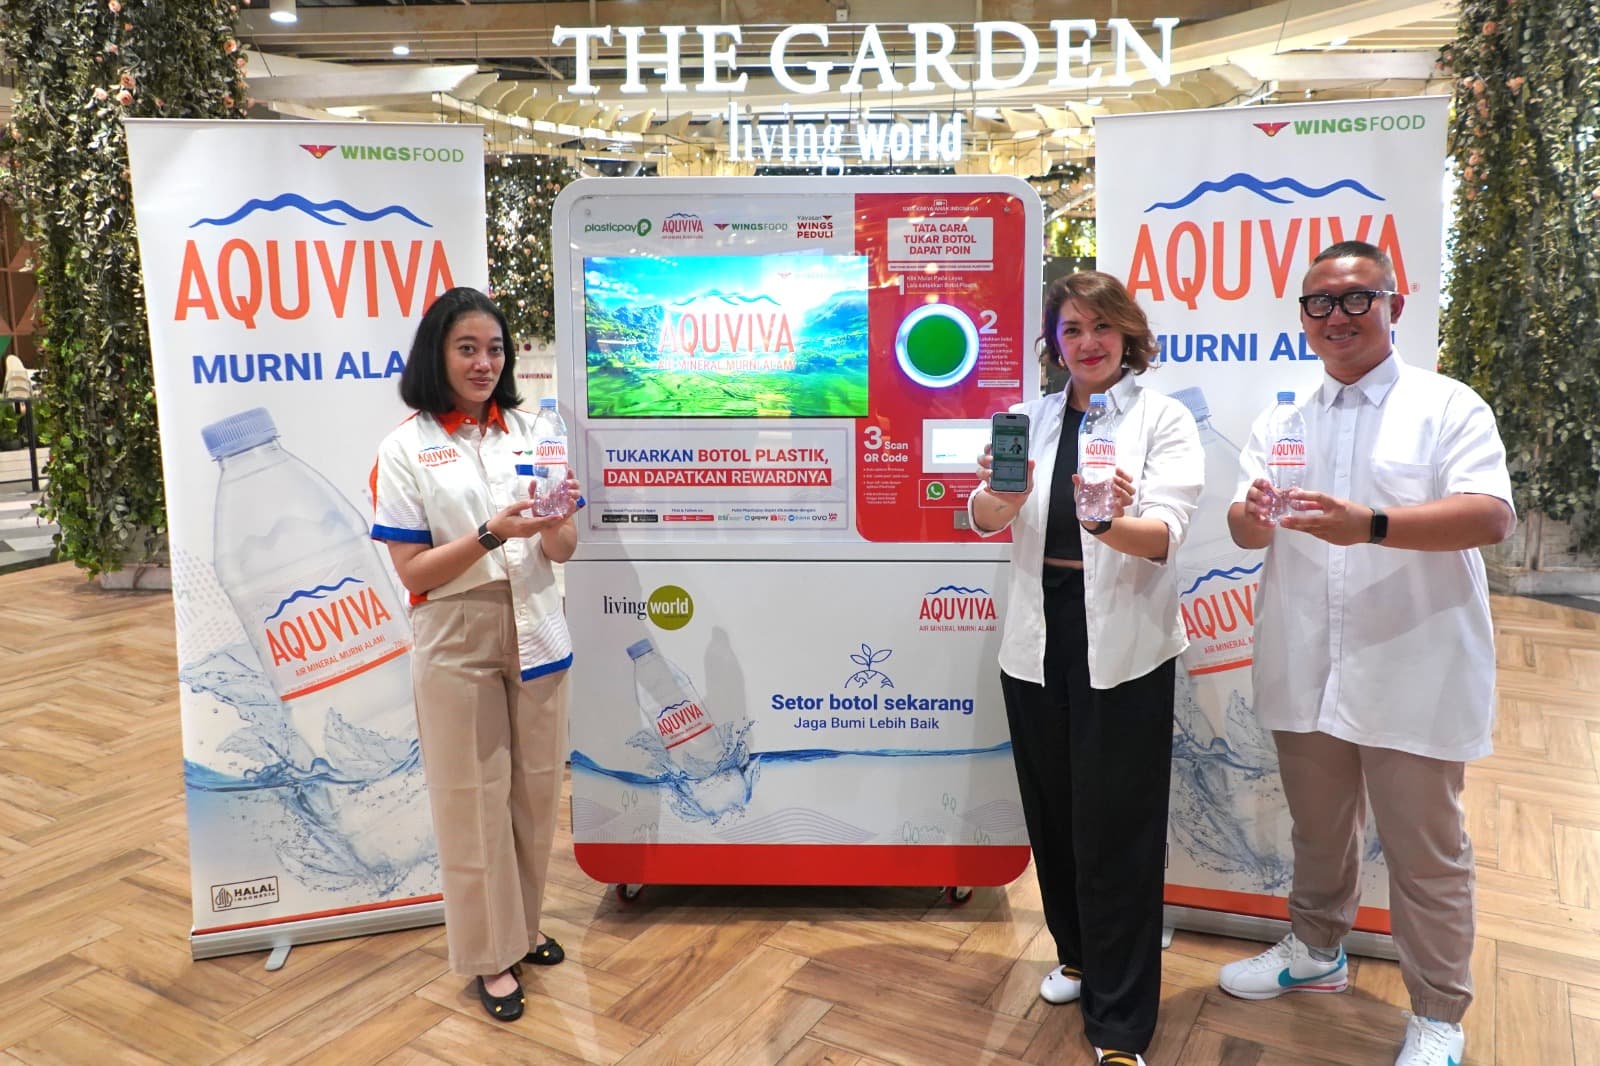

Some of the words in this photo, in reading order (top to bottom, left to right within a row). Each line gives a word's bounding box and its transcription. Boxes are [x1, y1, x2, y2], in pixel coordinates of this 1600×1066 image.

[551, 25, 748, 93] THE
[770, 18, 1180, 93] GARDEN
[1294, 115, 1425, 135] WINGSFOOD
[728, 101, 844, 176] living
[857, 112, 962, 161] world
[340, 145, 464, 162] WINGSFOOD
[584, 222, 638, 233] plasticpay
[662, 219, 704, 234] AQUVIVA
[731, 223, 788, 231] WINGSFOOD
[797, 222, 833, 230] WINGS
[797, 231, 833, 239] PEDULI
[912, 223, 937, 233] TATA
[939, 223, 968, 233] CARA
[904, 234, 940, 244] TUKAR
[942, 234, 977, 244] BOTOL
[909, 245, 942, 255] DAPAT
[945, 245, 971, 255] POIN
[174, 238, 456, 329] AQUVIVA
[979, 309, 998, 334] 2
[658, 313, 794, 356] AQUVIVA
[192, 353, 322, 384] MURNI
[335, 351, 407, 380] ALA
[864, 425, 882, 450] 3
[884, 441, 908, 450] Scan
[606, 449, 694, 463] TUKARKAN
[698, 449, 750, 463] BOTOL
[756, 449, 829, 464] PLASTIK,
[864, 453, 879, 463] QR
[881, 453, 908, 463] Code
[607, 470, 640, 484] DAN
[644, 470, 729, 484] DAPATKAN
[731, 470, 828, 484] REWARDNYA
[603, 595, 647, 620] living
[650, 597, 688, 614] world
[919, 597, 996, 622] AQUVIVA
[1181, 583, 1258, 640] AQUV
[265, 587, 392, 667] AQUVIVA
[307, 655, 339, 673] MINERAL
[771, 694, 823, 710] Setor
[829, 694, 878, 710] botol
[884, 694, 974, 715] sekarang
[658, 703, 704, 736] AQUVIVA
[794, 717, 827, 731] Jaga
[831, 717, 865, 729] Bumi
[869, 717, 906, 729] Lebih
[910, 717, 940, 729] Baik
[234, 883, 275, 896] HALAL
